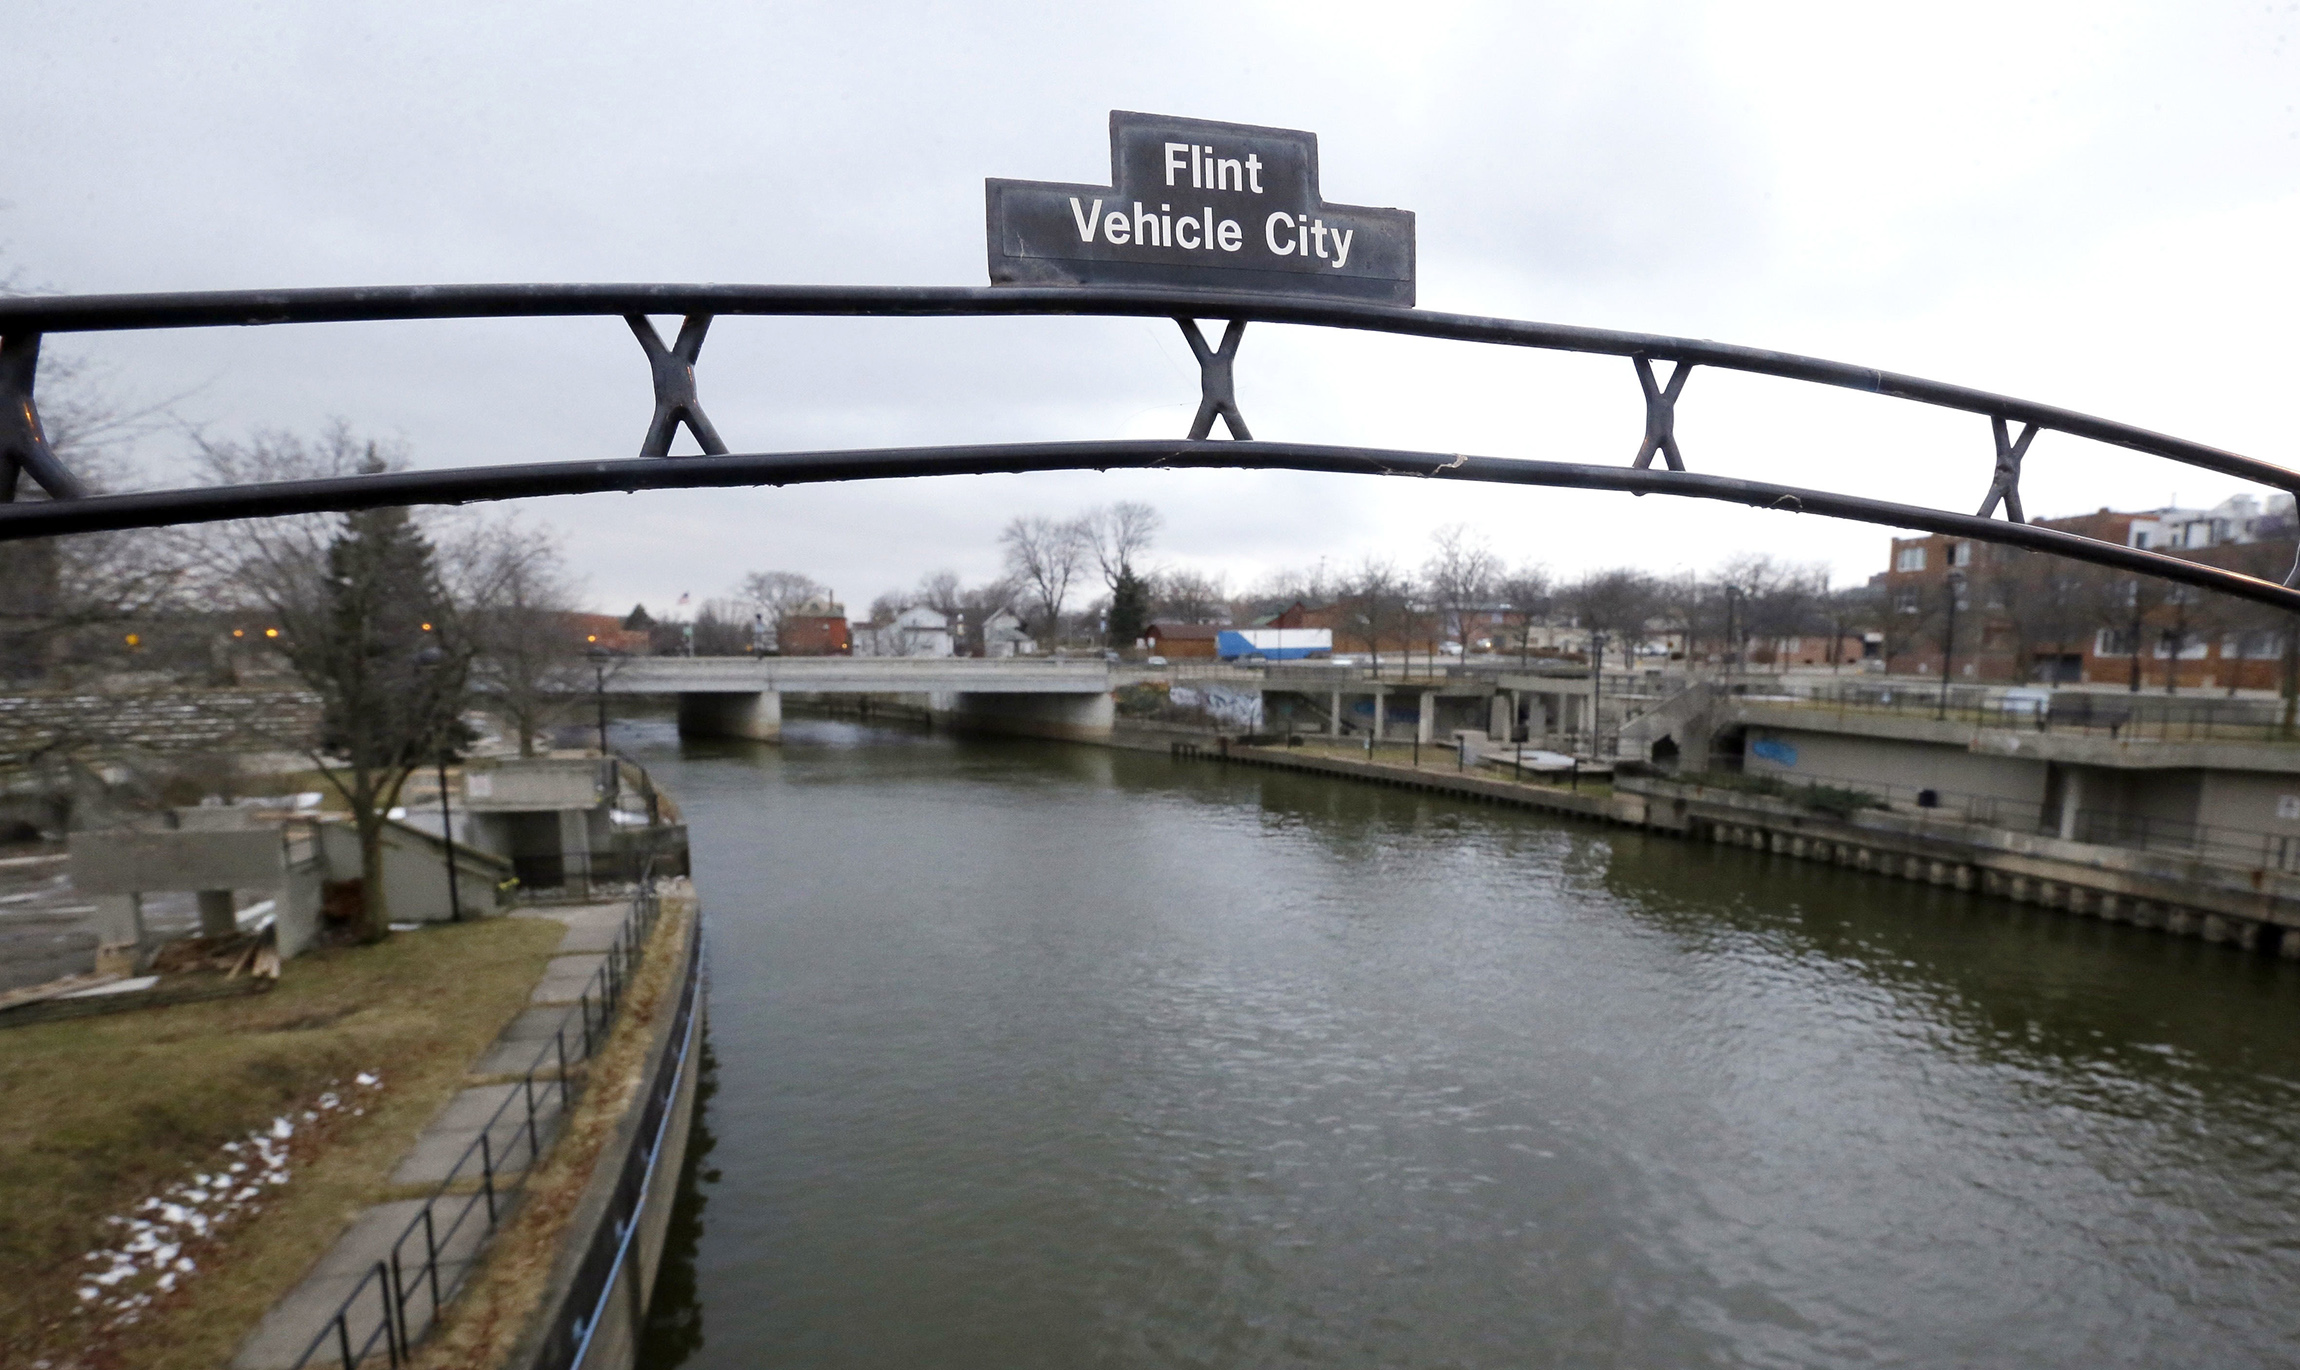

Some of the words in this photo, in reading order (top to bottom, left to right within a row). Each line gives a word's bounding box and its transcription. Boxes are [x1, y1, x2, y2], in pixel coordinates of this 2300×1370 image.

[1164, 142, 1263, 194] Flint
[1069, 197, 1243, 252] Vehicle
[1265, 211, 1354, 268] City
